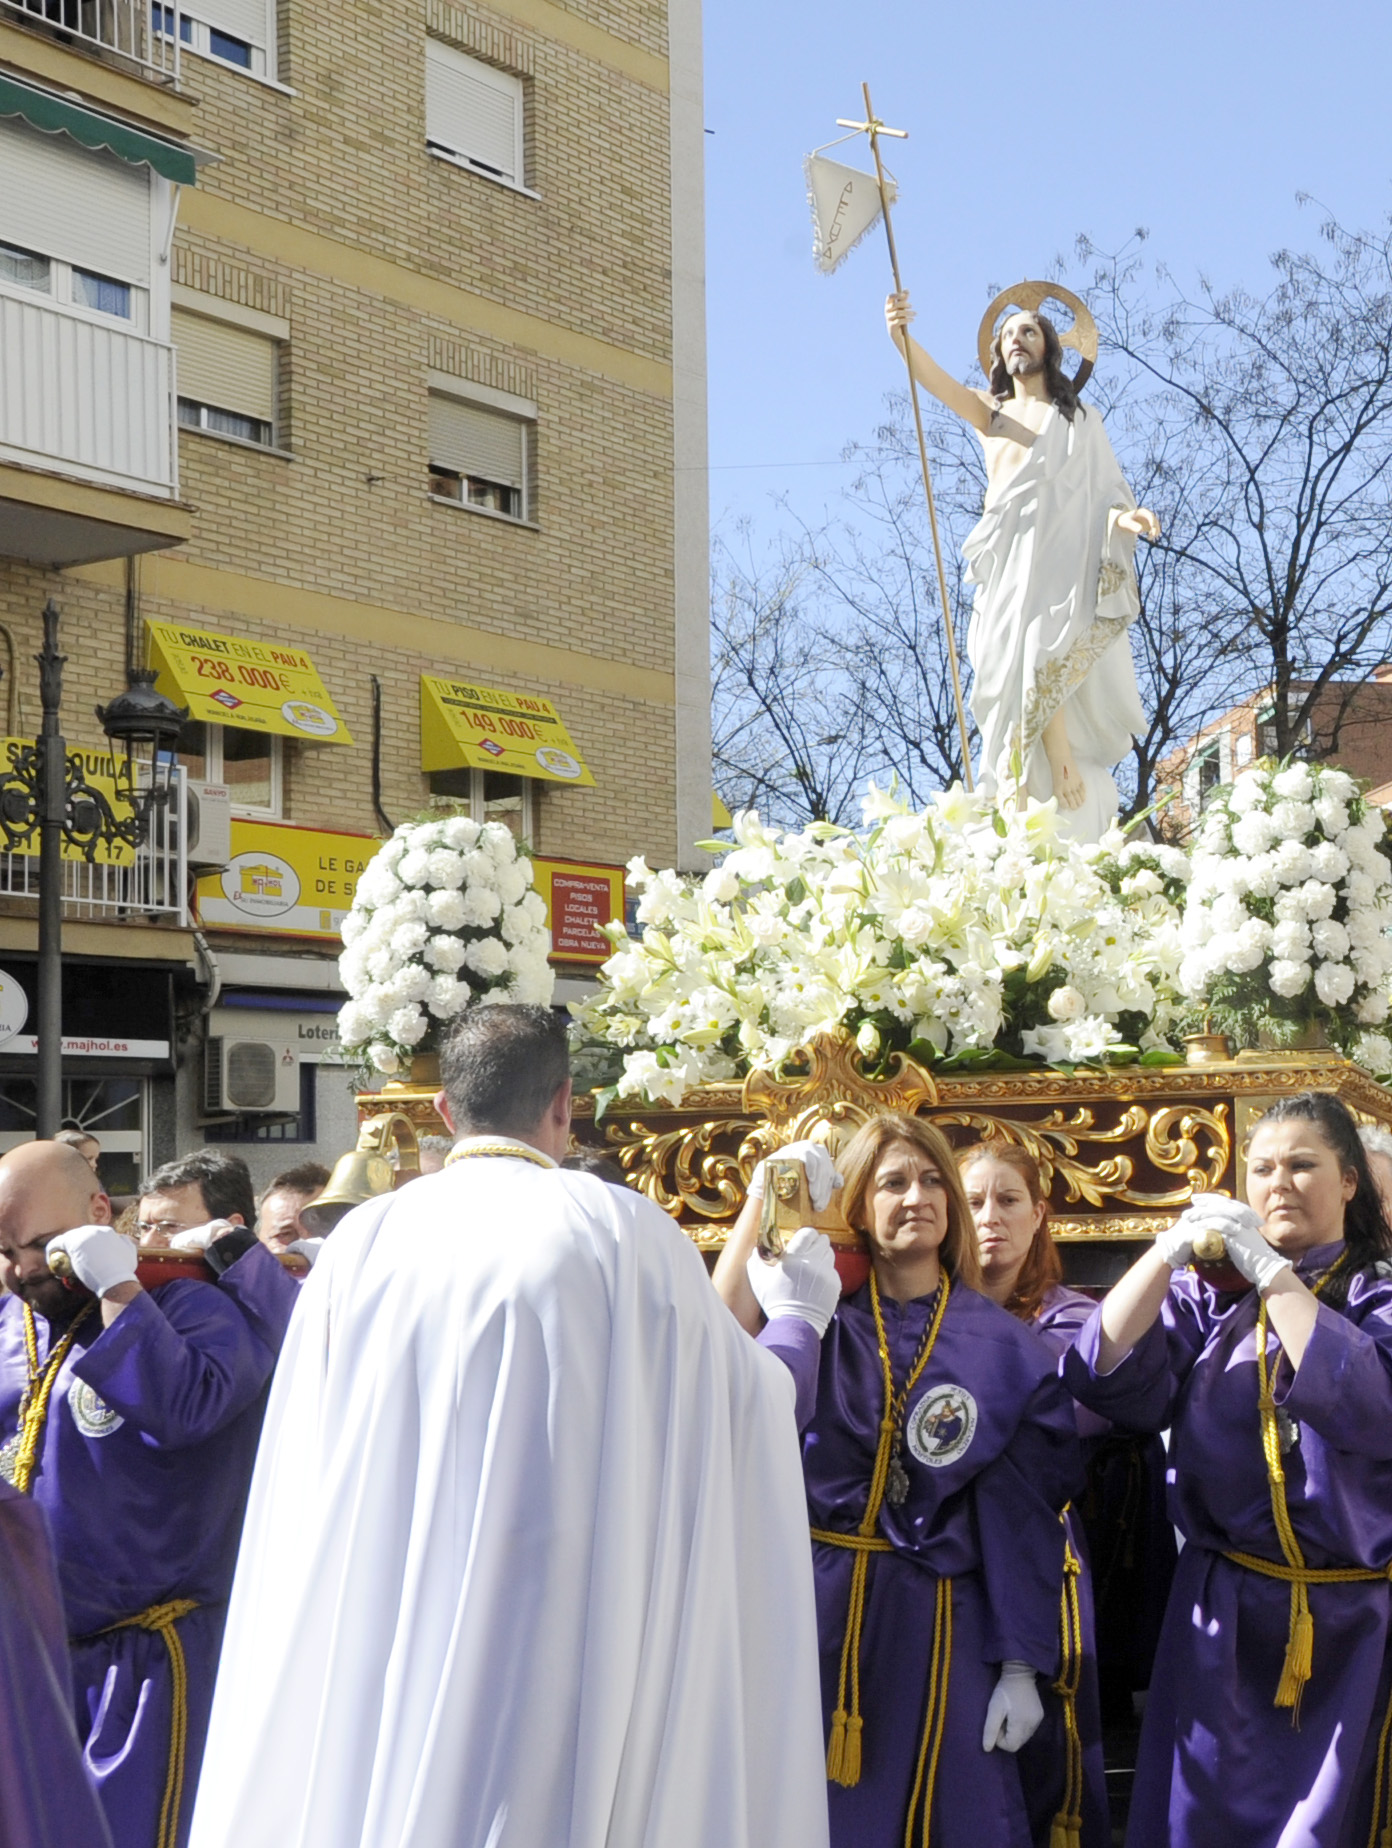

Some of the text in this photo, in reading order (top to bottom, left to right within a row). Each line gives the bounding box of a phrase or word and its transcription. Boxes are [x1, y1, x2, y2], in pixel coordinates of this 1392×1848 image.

[157, 627, 309, 670] TU CHALET EN EL PAU 4
[431, 680, 450, 696] TU
[451, 684, 480, 701] PISO
[480, 689, 498, 704] EN
[500, 693, 517, 709] EL
[515, 697, 540, 713] PAU
[542, 703, 550, 715] 4
[203, 787, 227, 798] SANYO
[319, 856, 365, 874] LE GA
[315, 879, 357, 896] DE S
[553, 879, 609, 892] COMPRA-VENTA
[569, 892, 593, 902] PISOS
[564, 903, 598, 914] LOCALES
[564, 915, 598, 926] CHALETS
[562, 926, 601, 938] PARCELAS
[558, 938, 606, 950] OBRA NUEVA
[298, 1023, 342, 1040] Loteri
[31, 1039, 128, 1052] w.majhol.es
